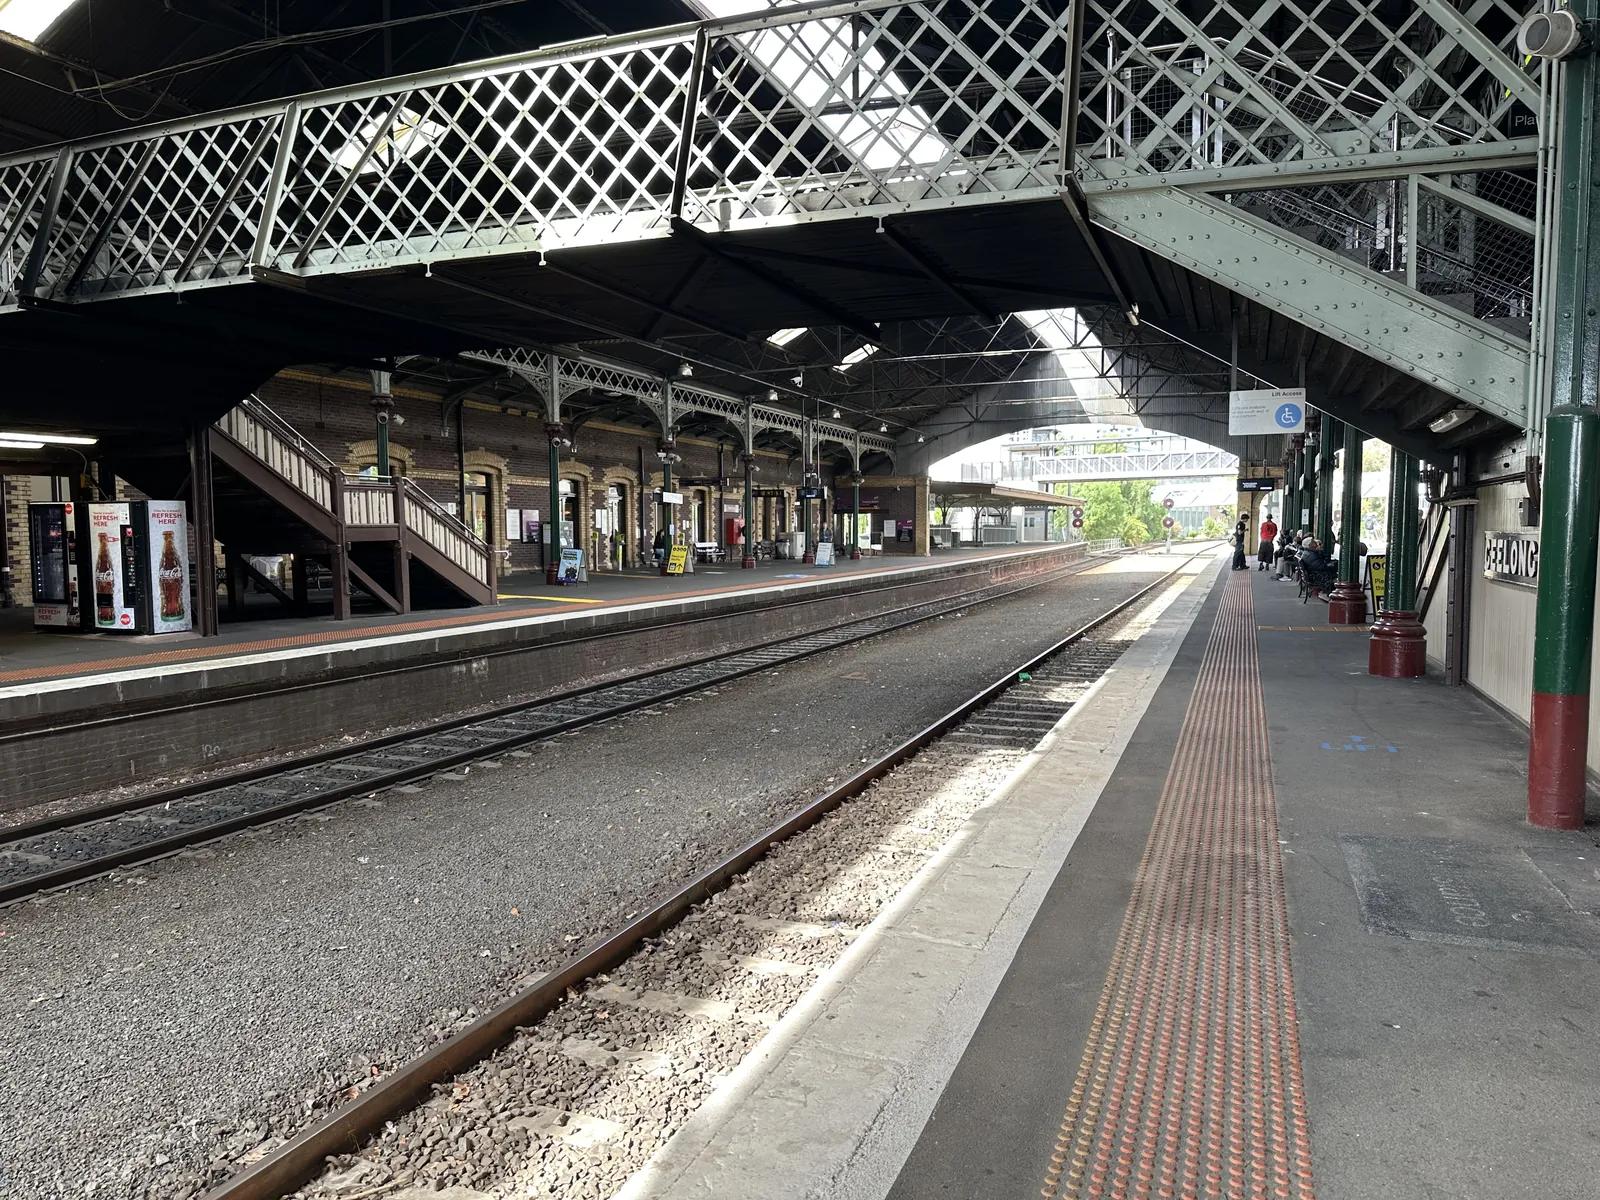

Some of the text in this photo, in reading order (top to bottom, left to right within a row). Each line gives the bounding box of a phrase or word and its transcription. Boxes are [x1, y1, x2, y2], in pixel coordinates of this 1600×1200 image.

[1515, 115, 1537, 126] Pla
[1484, 538, 1539, 578] GEELONG
[1320, 741, 1403, 754] LIFT
